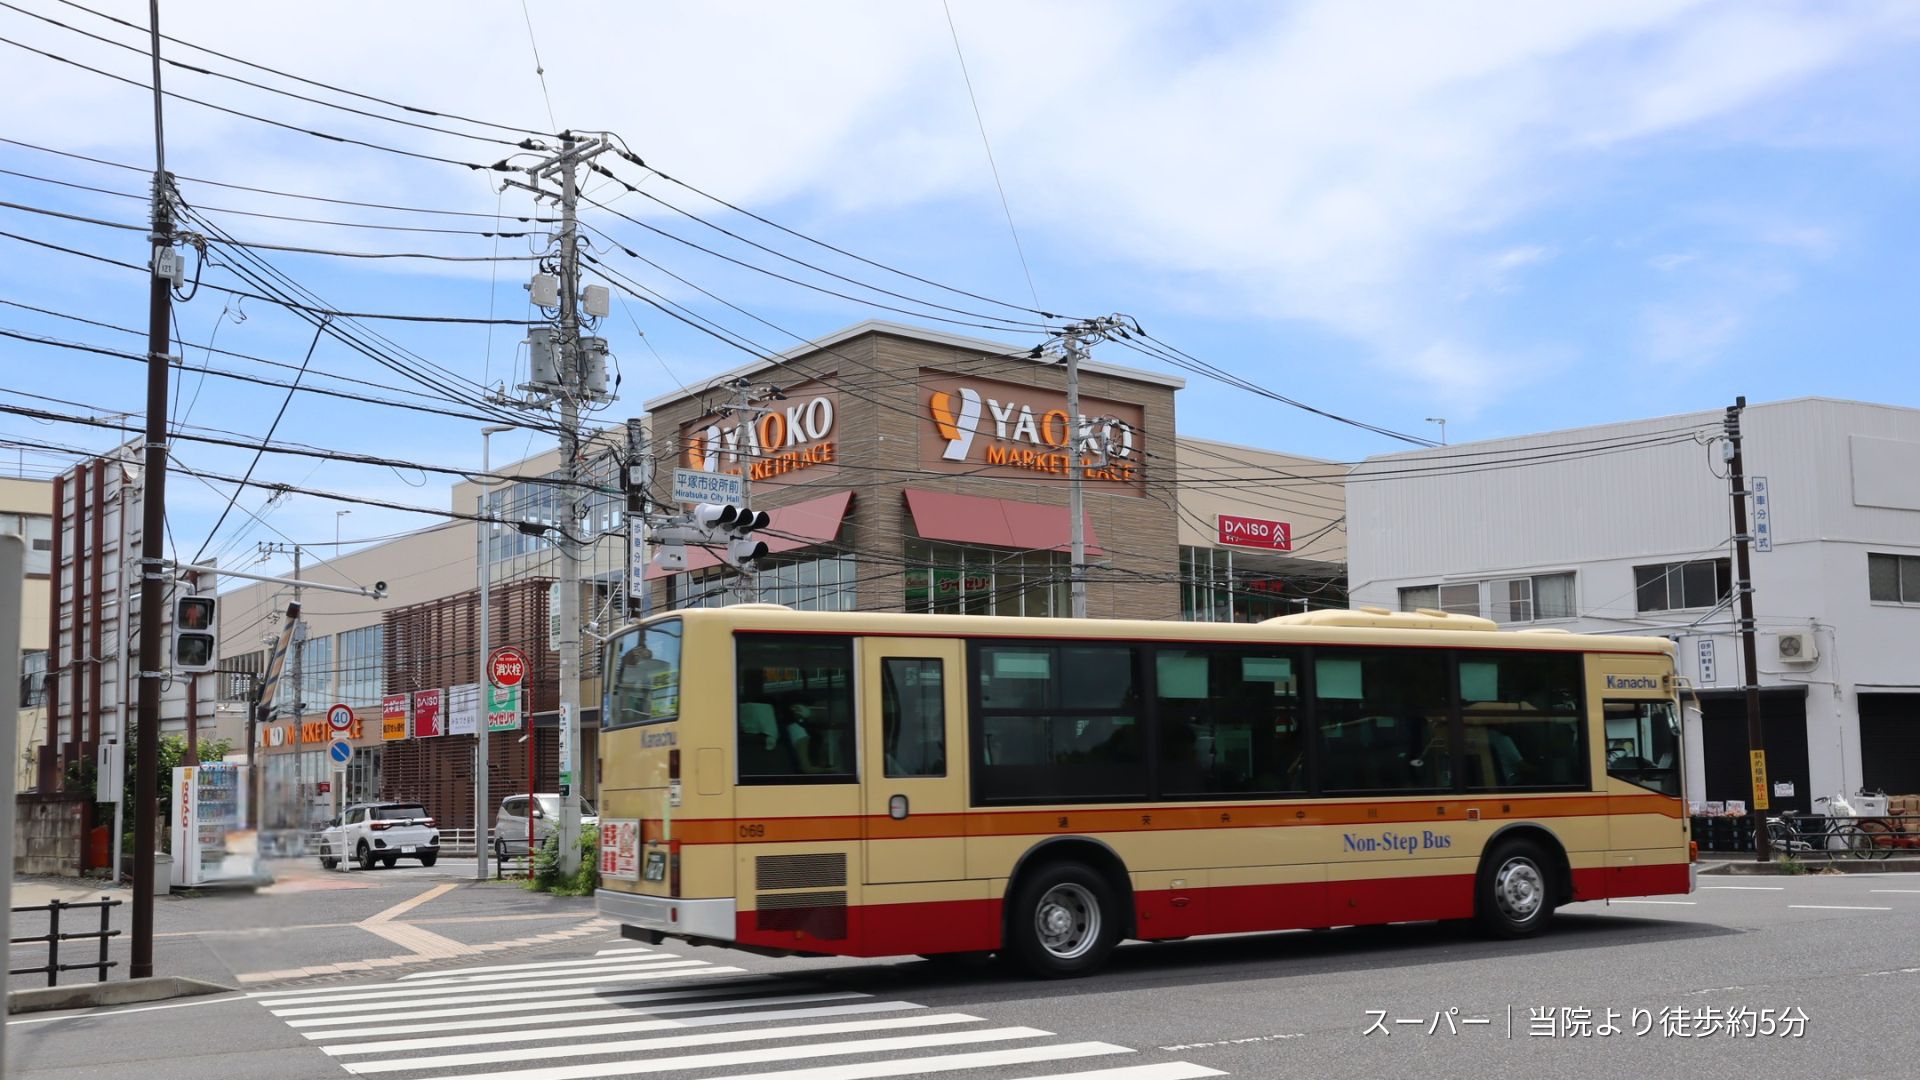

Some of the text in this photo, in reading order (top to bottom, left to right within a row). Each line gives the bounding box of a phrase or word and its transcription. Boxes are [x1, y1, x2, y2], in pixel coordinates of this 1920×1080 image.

[722, 396, 834, 464] YAOKO
[986, 398, 1132, 458] YAOKO
[723, 441, 834, 481] RKETPLACE
[986, 444, 1136, 481] MARKETLACE
[676, 473, 740, 494] 平塚市役所前
[675, 490, 740, 503] Hiratsuka City Hall
[1754, 481, 1769, 549] 歩車分離式
[1224, 520, 1270, 537] DAISO
[496, 663, 521, 676] 消火栓
[1606, 675, 1657, 689] Kanachu
[416, 696, 438, 708] DAISO
[333, 711, 349, 724] 40
[488, 712, 516, 728] サイゼリヤ
[1343, 830, 1452, 854] Non-Step Bus
